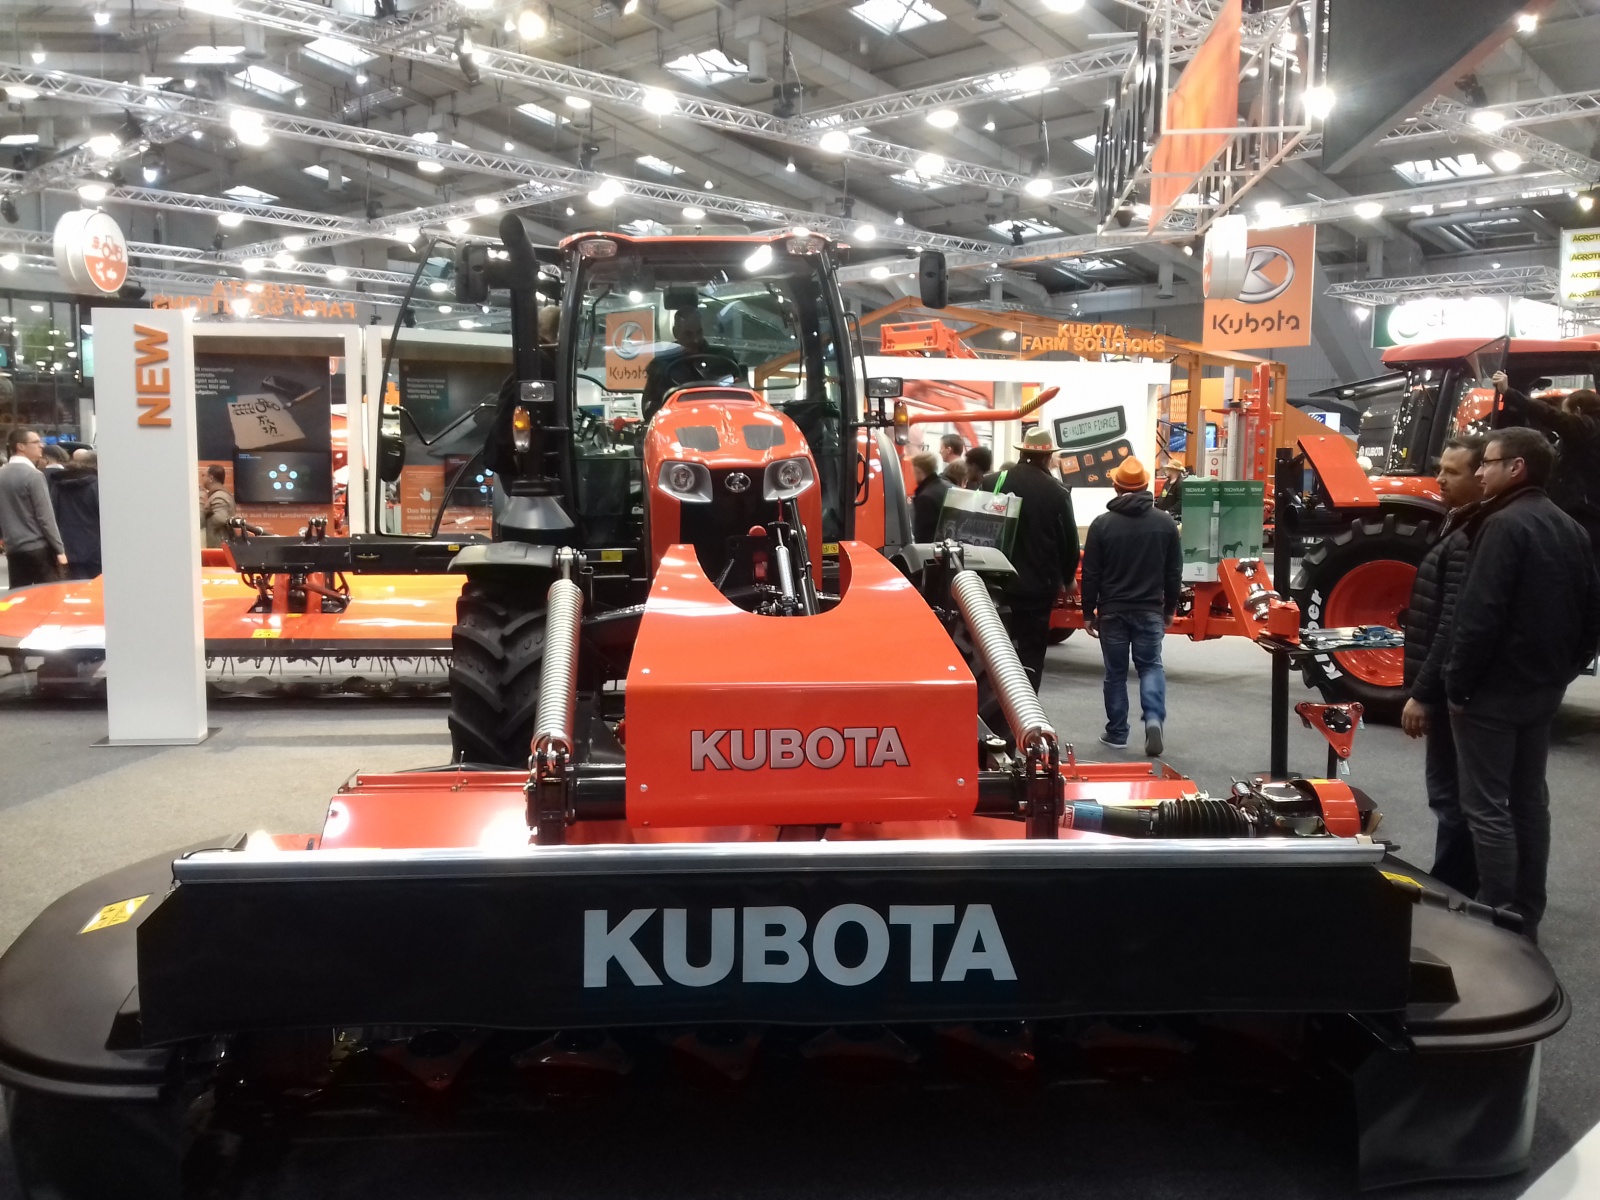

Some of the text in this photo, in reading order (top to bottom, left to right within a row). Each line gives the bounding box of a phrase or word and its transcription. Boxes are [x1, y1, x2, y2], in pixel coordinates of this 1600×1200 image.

[1572, 233, 1600, 242] AGROT
[1057, 323, 1126, 339] KUBOTA
[1212, 309, 1300, 335] Kubota
[1021, 336, 1166, 353] FARM SOLUTIONS
[133, 323, 172, 428] NEW
[1365, 446, 1384, 457] KUBOTA
[690, 726, 911, 772] KUBOTA
[583, 903, 1018, 988] KUBOTA
